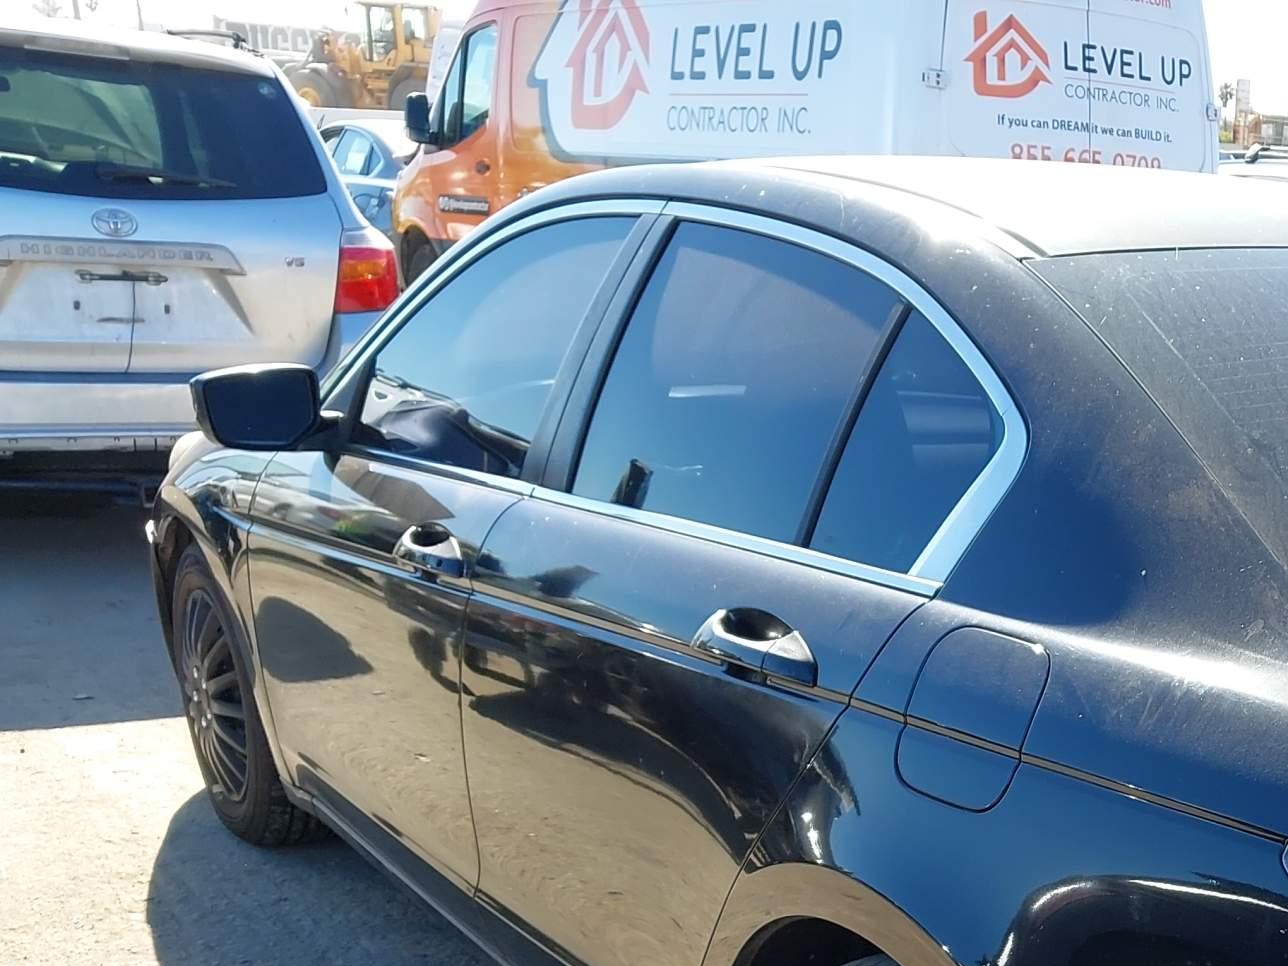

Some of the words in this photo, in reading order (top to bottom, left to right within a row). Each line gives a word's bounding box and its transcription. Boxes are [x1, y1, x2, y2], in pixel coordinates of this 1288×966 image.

[670, 23, 775, 80] LEVEL
[791, 20, 842, 81] UP
[1064, 41, 1151, 81] LEVEL
[1161, 56, 1191, 87] UP
[1064, 84, 1150, 108] CONTRACTOR
[1156, 96, 1179, 112] INC.
[666, 106, 768, 133] CONTRACTOR
[777, 107, 811, 134] INC.
[997, 114, 1006, 126] If
[1008, 116, 1028, 128] you
[1031, 119, 1049, 130] can
[1052, 119, 1090, 133] DREAM
[1091, 122, 1098, 134] it
[1100, 126, 1114, 136] we
[1116, 128, 1132, 139] can
[1134, 128, 1162, 142] BUILD
[1164, 132, 1173, 143] it.
[1010, 143, 1052, 161] 855
[20, 242, 214, 262] HIGHLANDER
